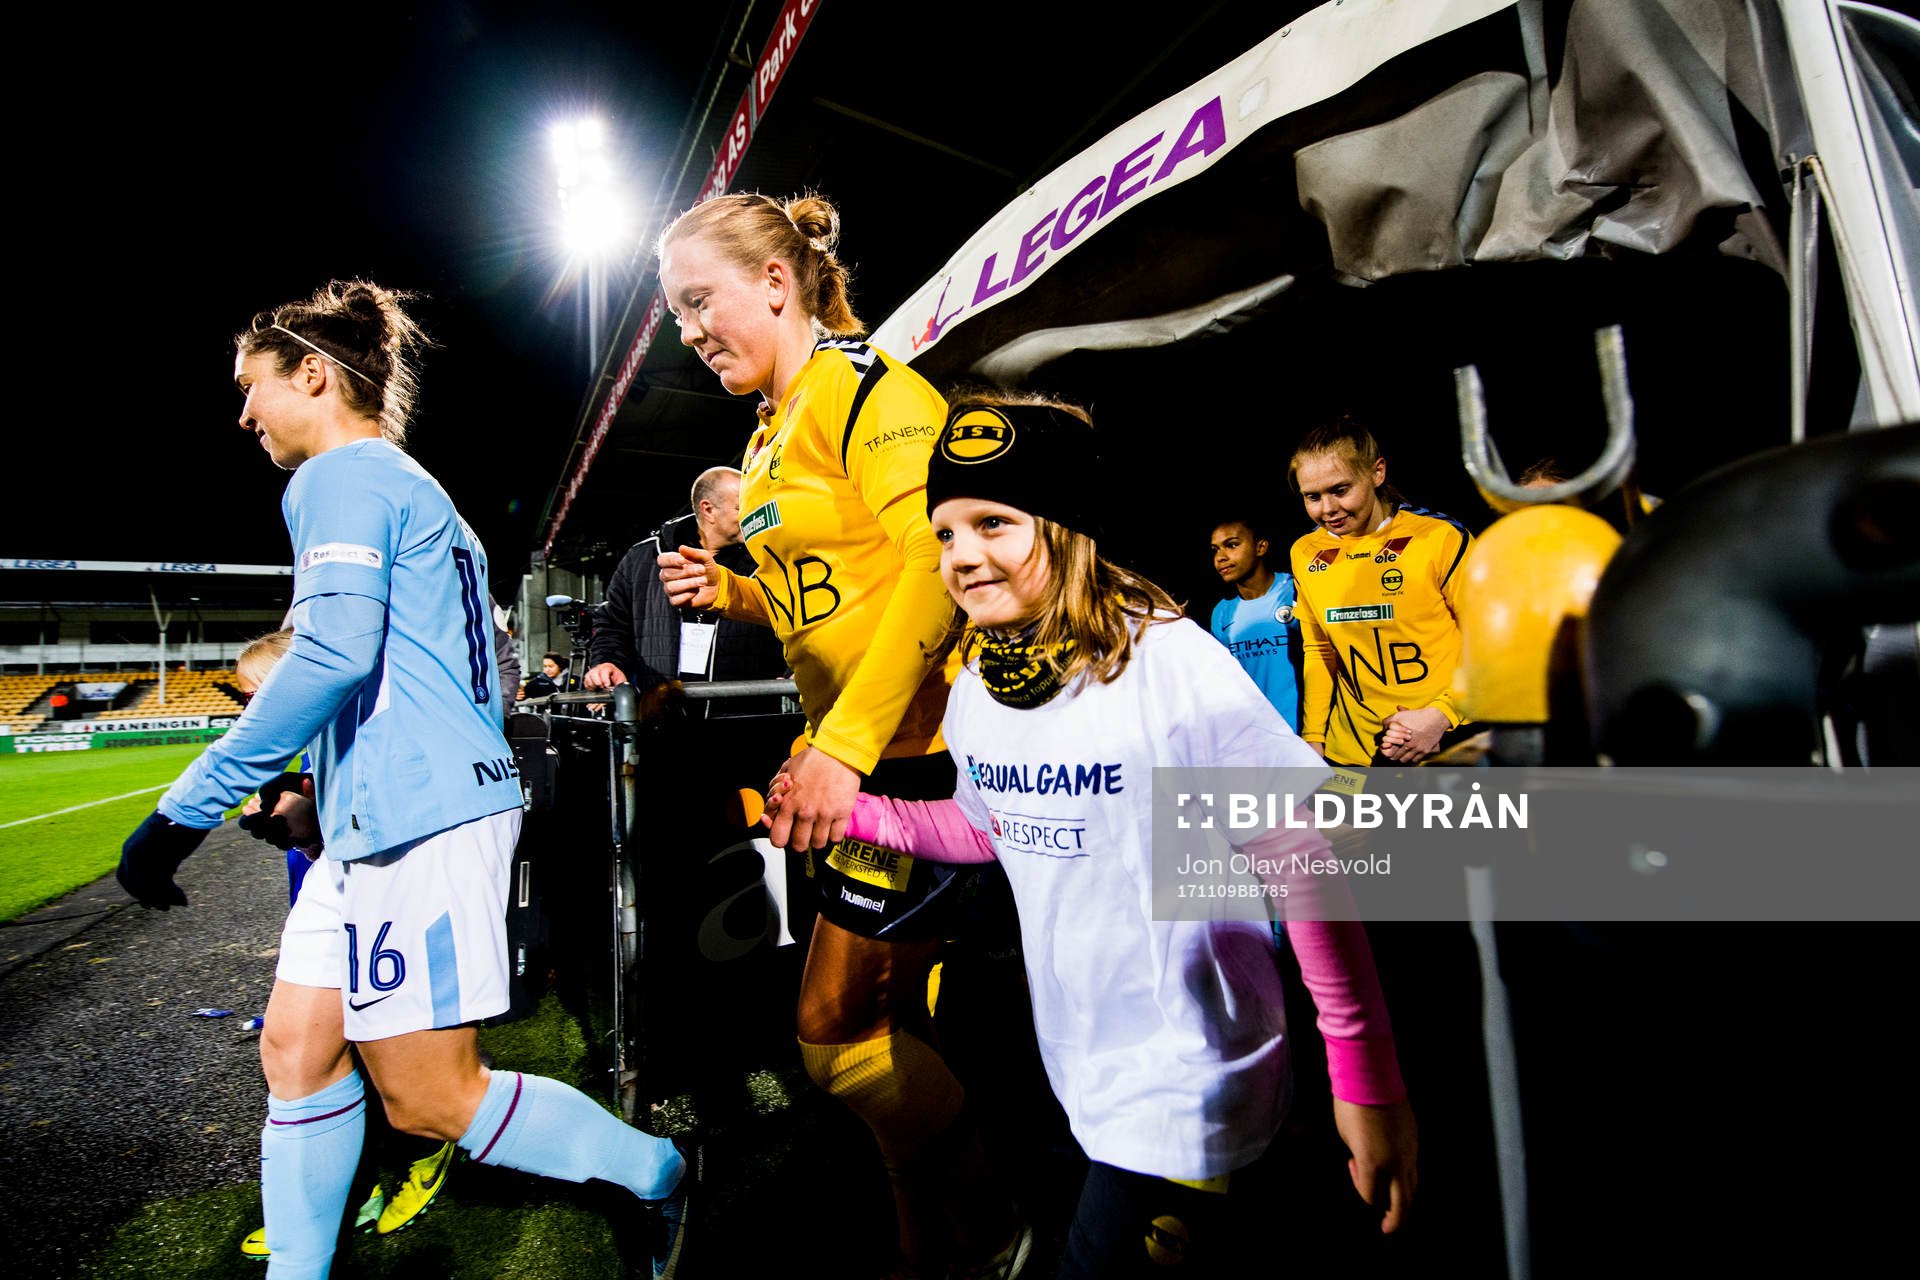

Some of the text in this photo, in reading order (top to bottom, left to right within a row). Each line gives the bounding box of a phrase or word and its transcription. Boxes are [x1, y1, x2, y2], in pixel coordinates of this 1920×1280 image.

[759, 8, 797, 104] Park
[727, 113, 747, 172] AS
[970, 95, 1227, 309] LEGEA
[864, 425, 936, 453] TRANEMO
[13, 559, 78, 570] LEGEA
[159, 562, 217, 573] LEGEA
[1330, 608, 1378, 621] Franzefoss
[95, 720, 200, 732] KRANRINGEN
[966, 754, 1125, 798] #EQUALGAME
[1003, 819, 1086, 850] RESPECT
[840, 885, 886, 913] hummel
[343, 921, 407, 994] 16
